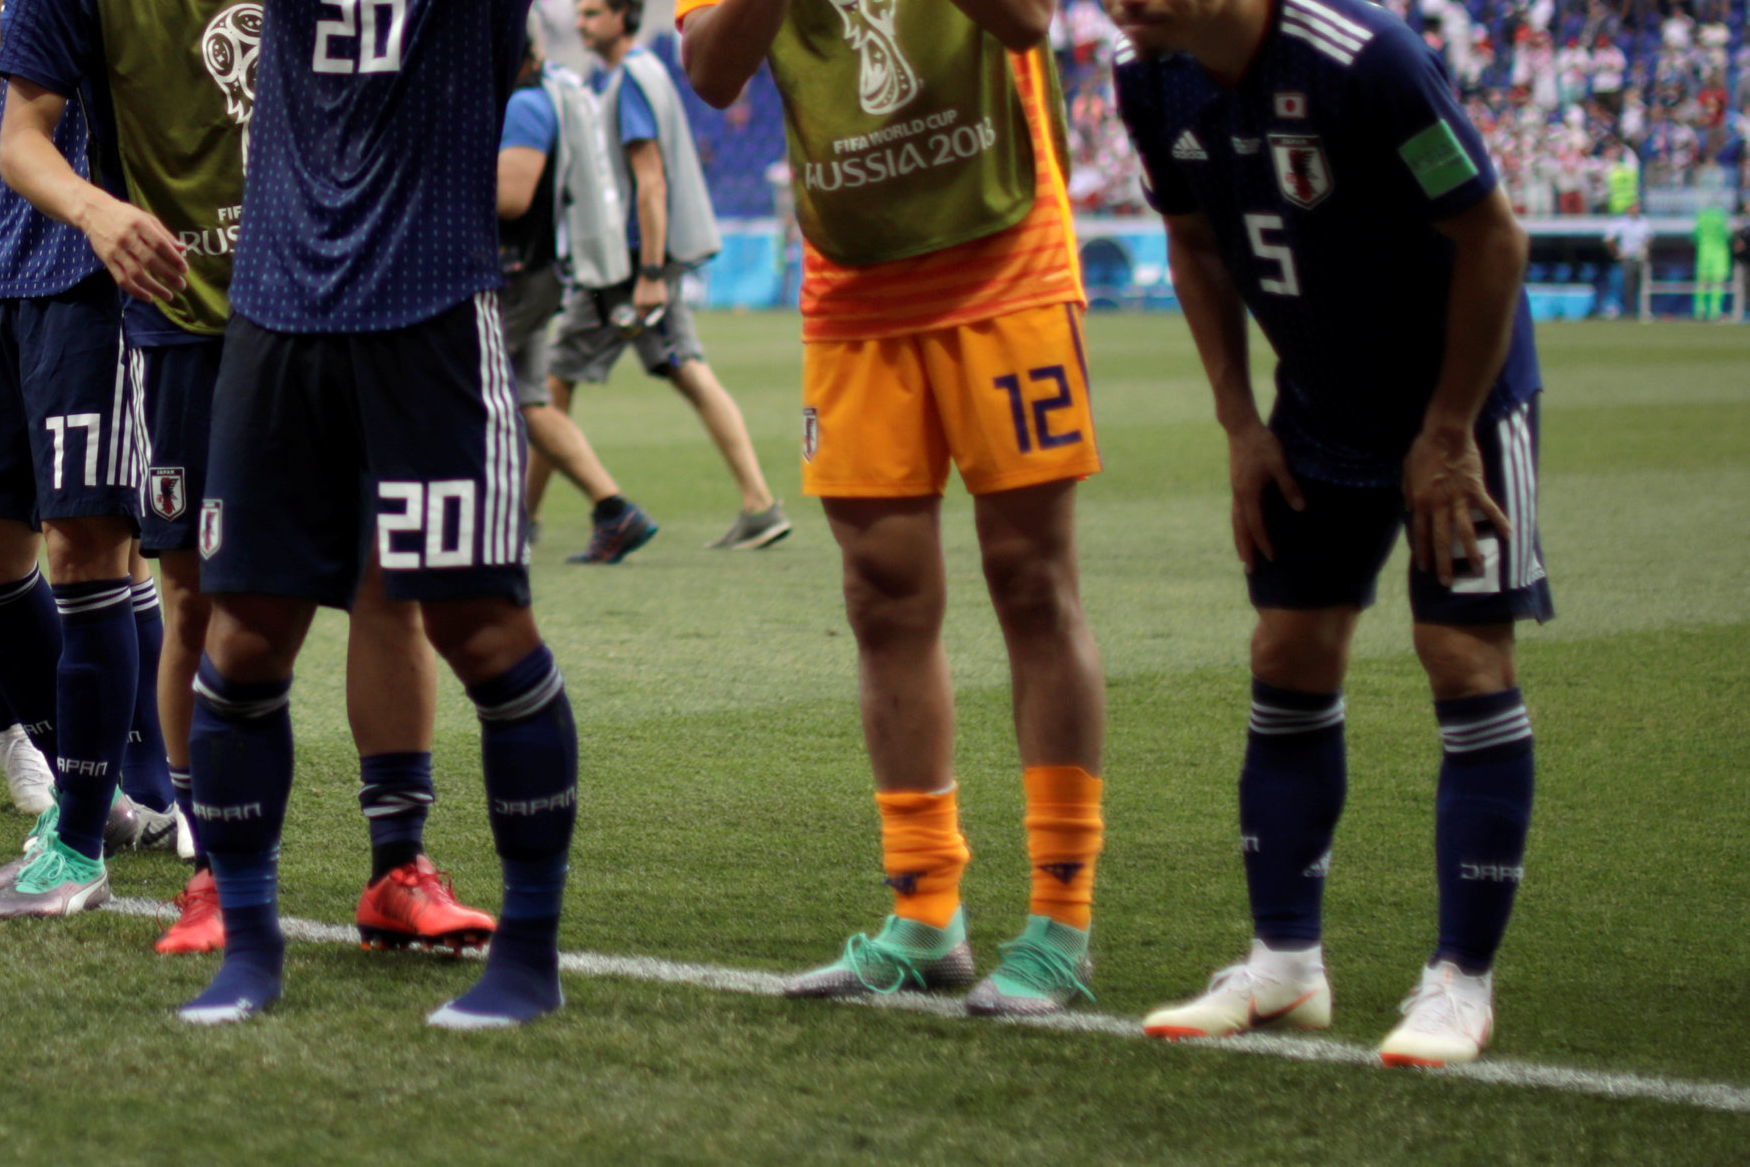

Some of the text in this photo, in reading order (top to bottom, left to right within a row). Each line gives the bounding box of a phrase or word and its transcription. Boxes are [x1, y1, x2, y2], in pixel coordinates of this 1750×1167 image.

[833, 109, 958, 154] FIFA WORLD CUP
[218, 205, 243, 222] FIF
[178, 225, 241, 257] RUS
[1244, 213, 1301, 296] 5
[992, 364, 1083, 455] 12
[46, 413, 101, 489] 17
[377, 479, 475, 569] 20
[57, 756, 108, 777] APAN
[192, 801, 263, 823] APAN
[1460, 863, 1524, 883] JAPA
